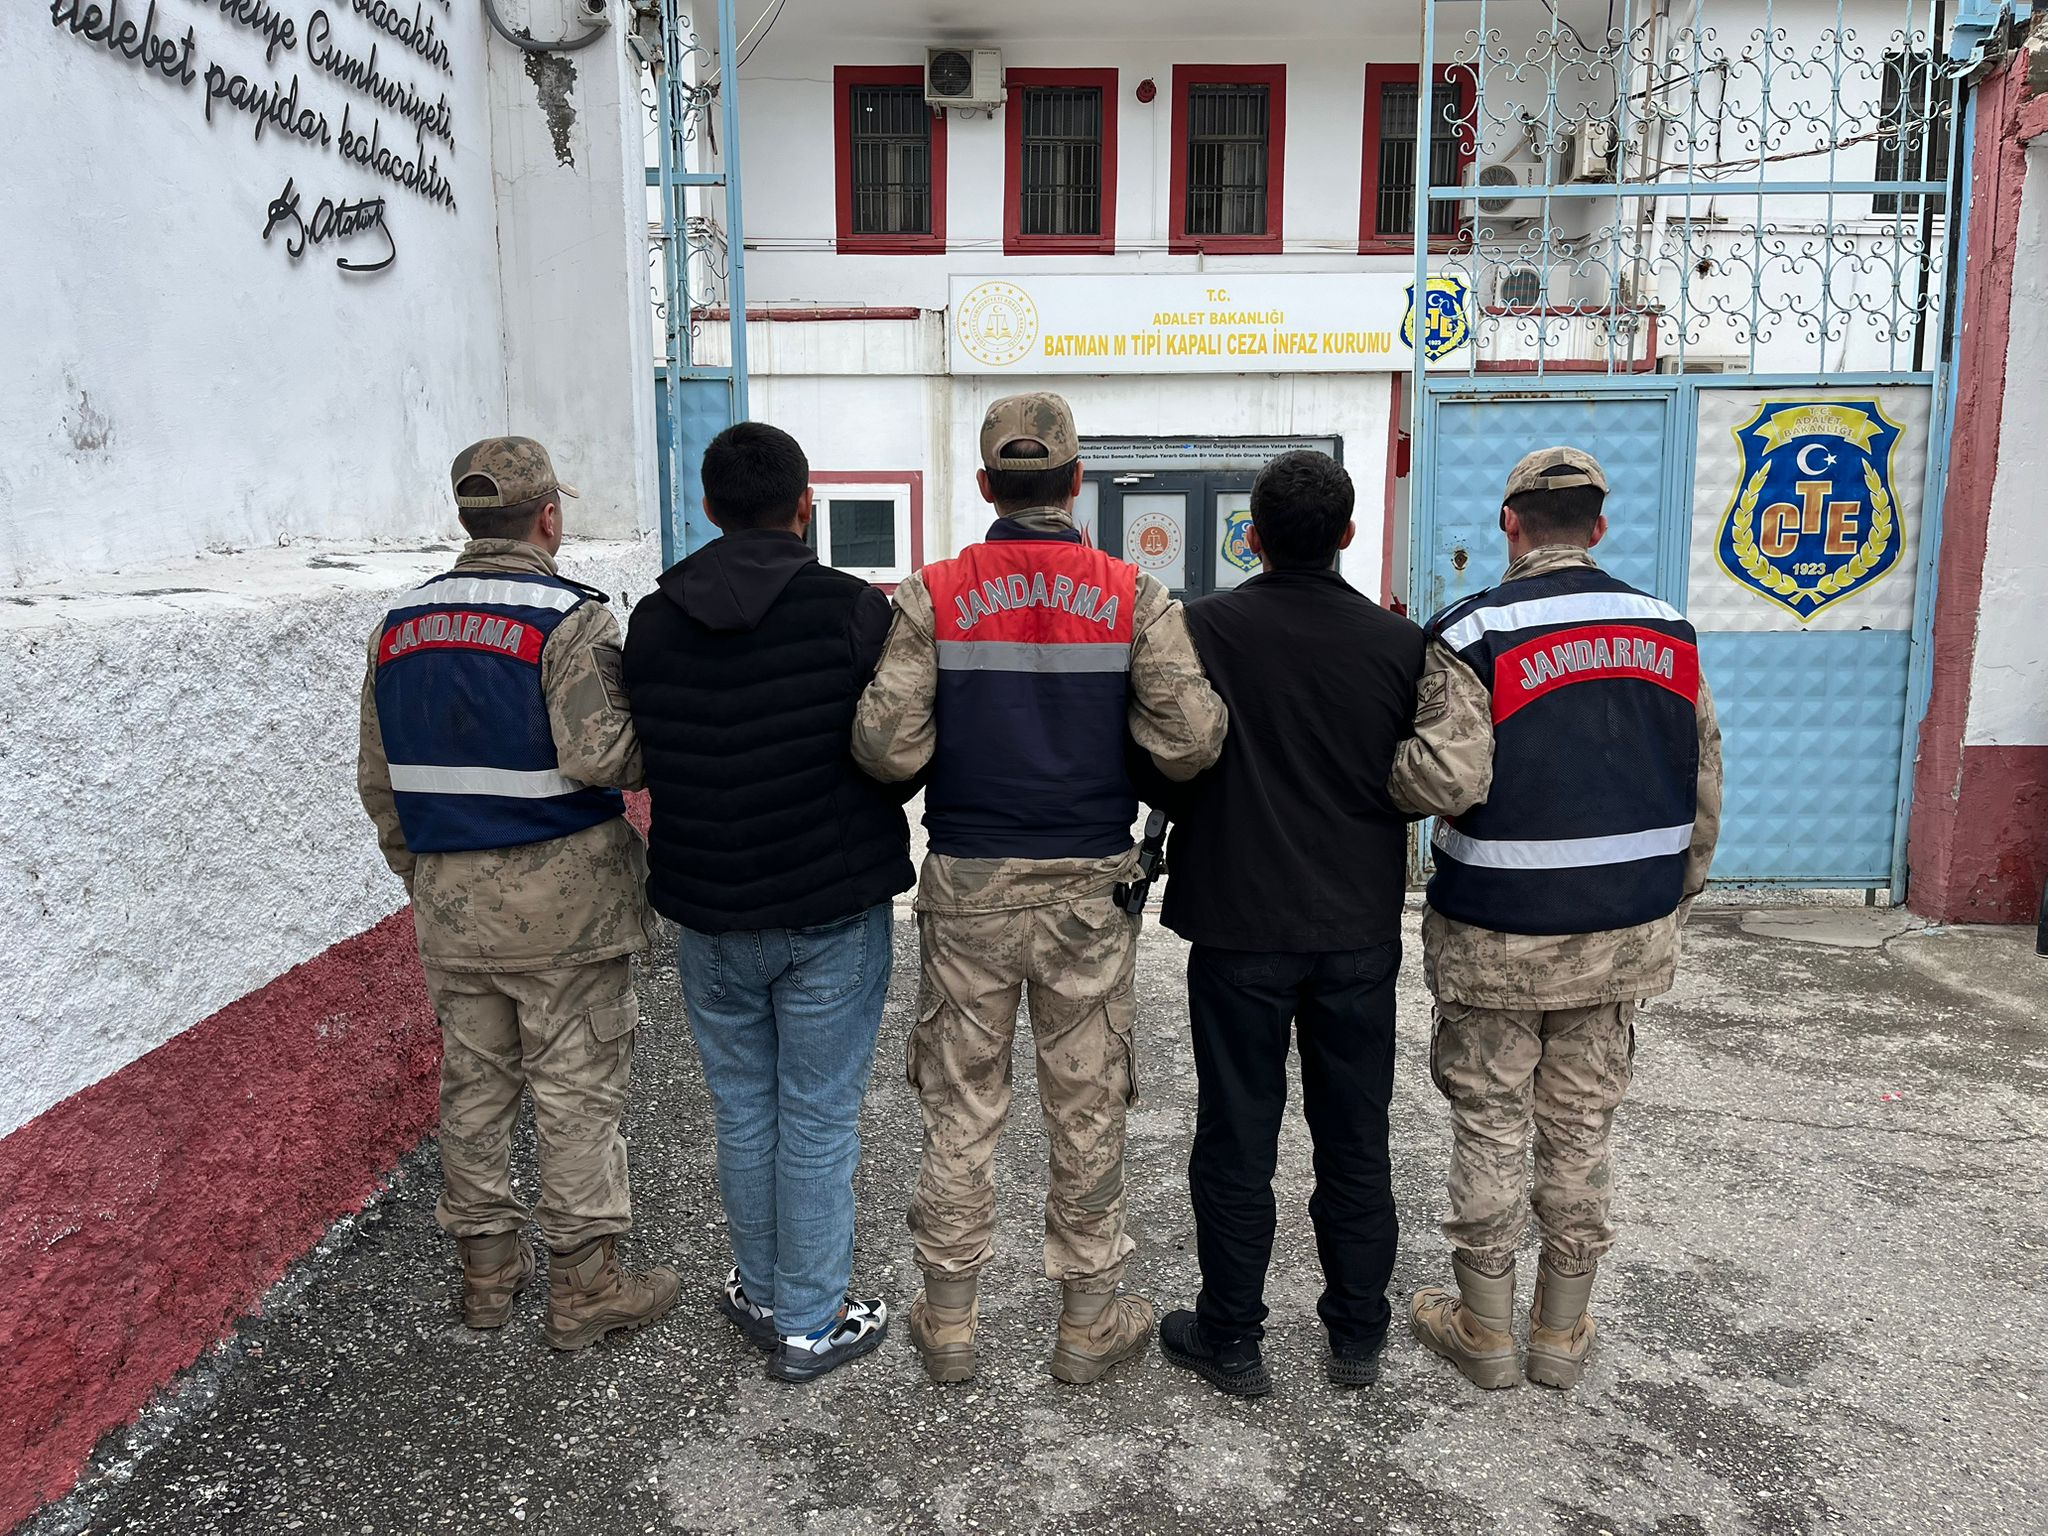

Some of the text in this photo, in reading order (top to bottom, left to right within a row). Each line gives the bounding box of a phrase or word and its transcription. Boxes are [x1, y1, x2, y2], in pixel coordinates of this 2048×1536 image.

[204, 61, 331, 141] payidar
[1206, 289, 1231, 302] T.C.
[1152, 308, 1284, 326] ADALET BAKANLIĞI
[1044, 328, 1391, 356] BATMAN M TİPİ KAPALI CEZA İNFAZ KURUMU
[1783, 424, 1854, 437] BAKANLIĞI
[1795, 416, 1842, 426] ADALET
[1759, 480, 1860, 558] CTE
[1792, 562, 1827, 576] 1923
[954, 572, 1120, 631] JANDARMA
[389, 614, 526, 655] JANDARMA
[1519, 637, 1674, 690] JANDARMA
